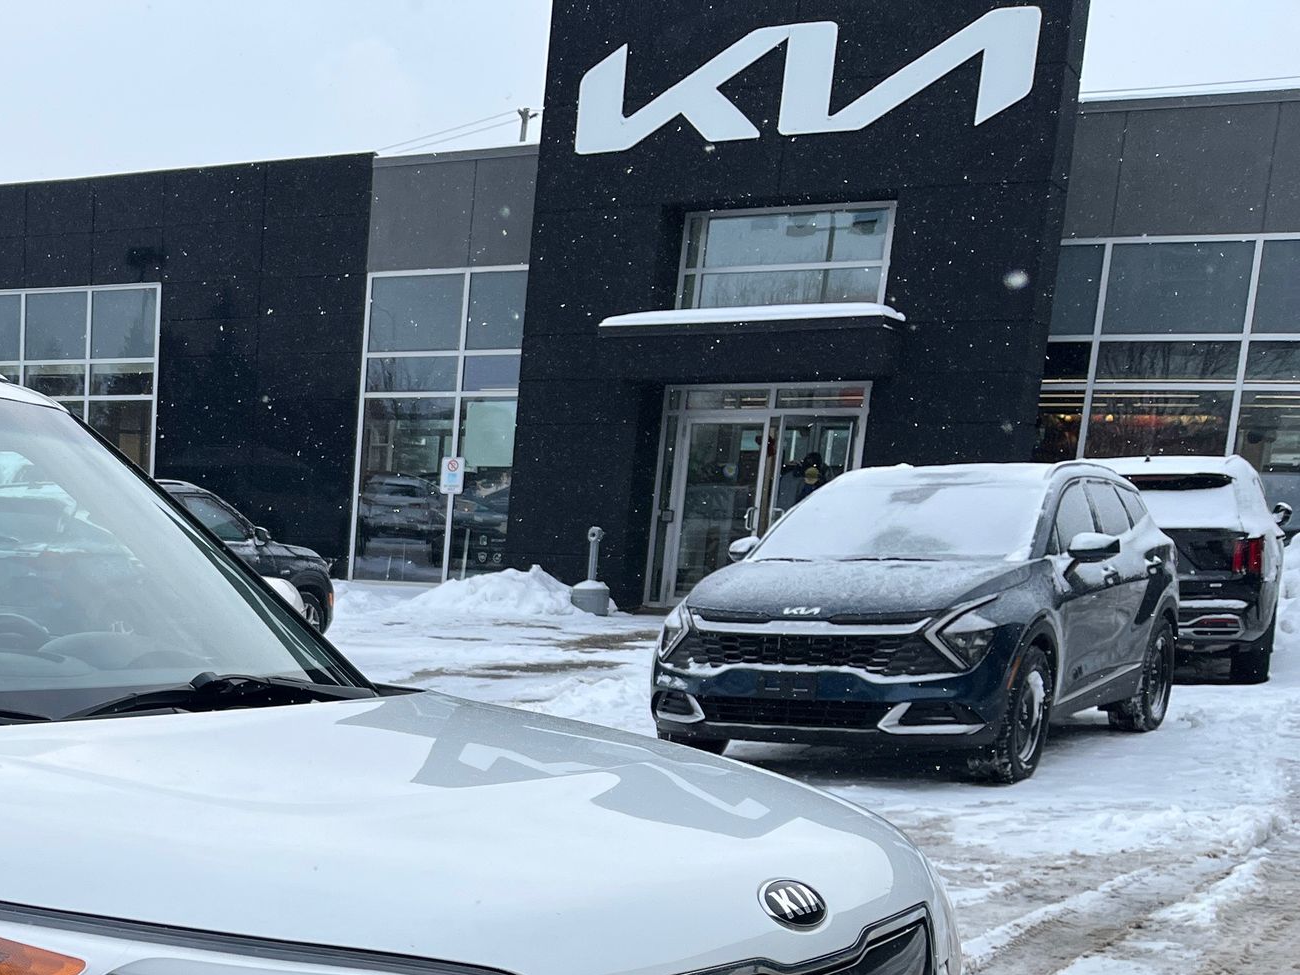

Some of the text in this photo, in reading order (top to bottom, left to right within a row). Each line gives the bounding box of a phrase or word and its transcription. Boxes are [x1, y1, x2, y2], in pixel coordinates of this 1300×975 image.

[575, 6, 1042, 155] KIA
[783, 606, 821, 615] KIA
[768, 884, 825, 919] KIA
